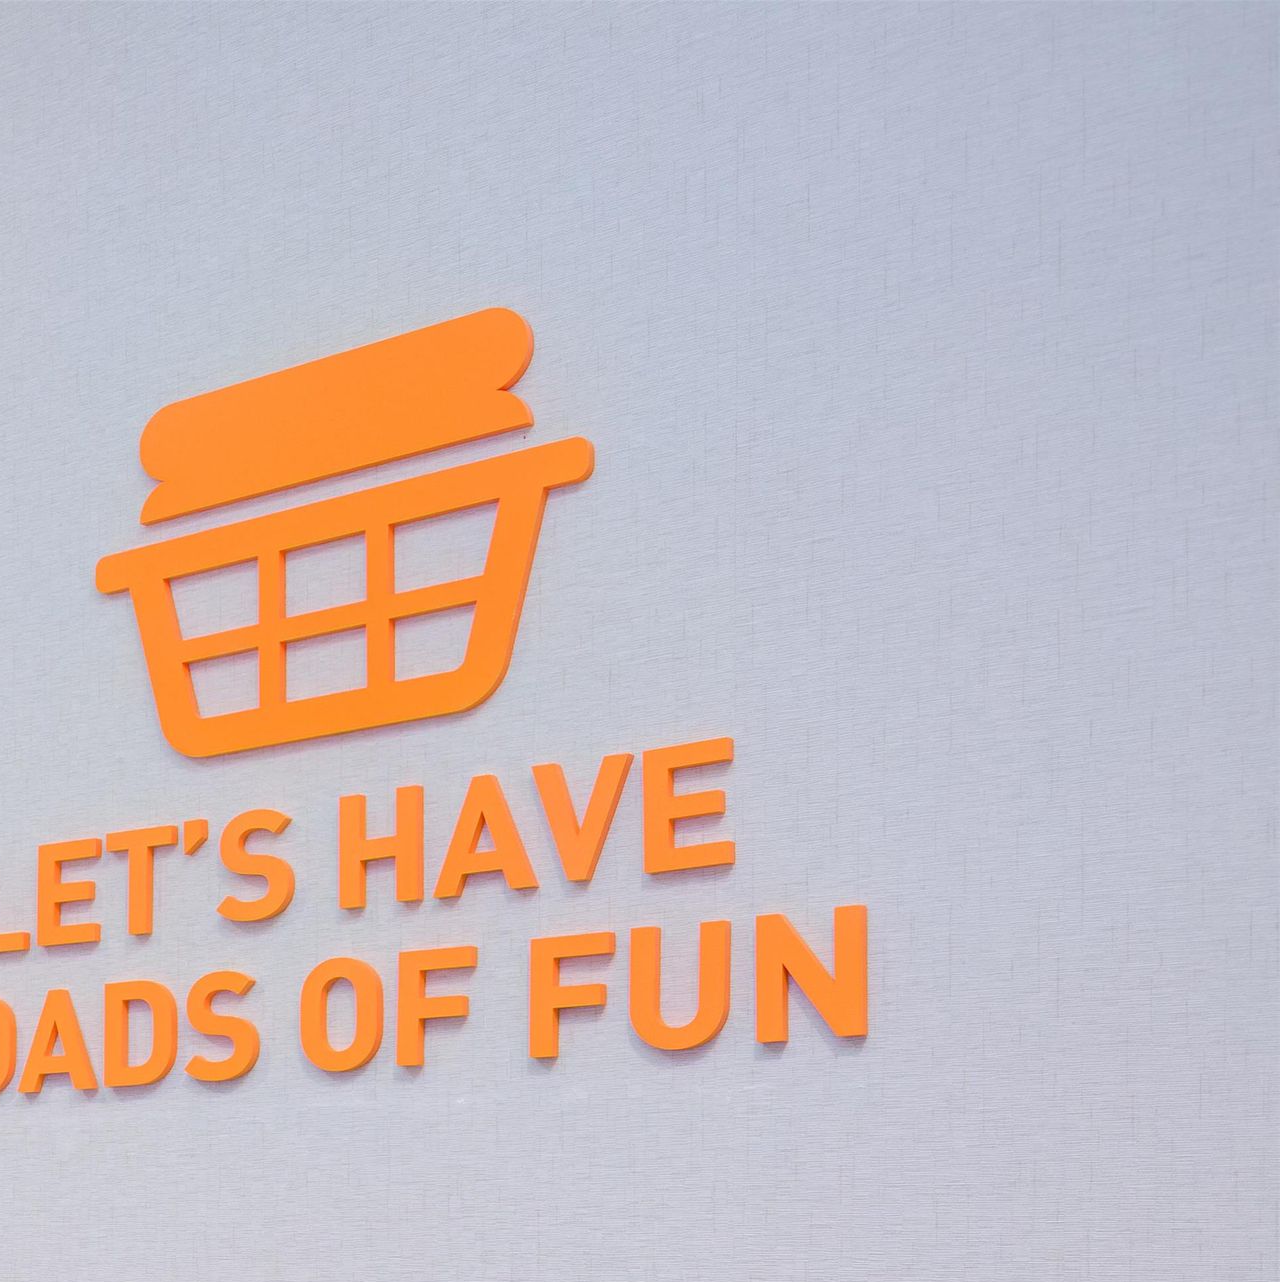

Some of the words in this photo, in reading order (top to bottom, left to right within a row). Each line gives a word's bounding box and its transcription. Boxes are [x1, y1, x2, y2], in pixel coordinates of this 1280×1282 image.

[339, 737, 737, 910] HAVE
[300, 945, 478, 1072] OF
[529, 905, 868, 1060] FUN
